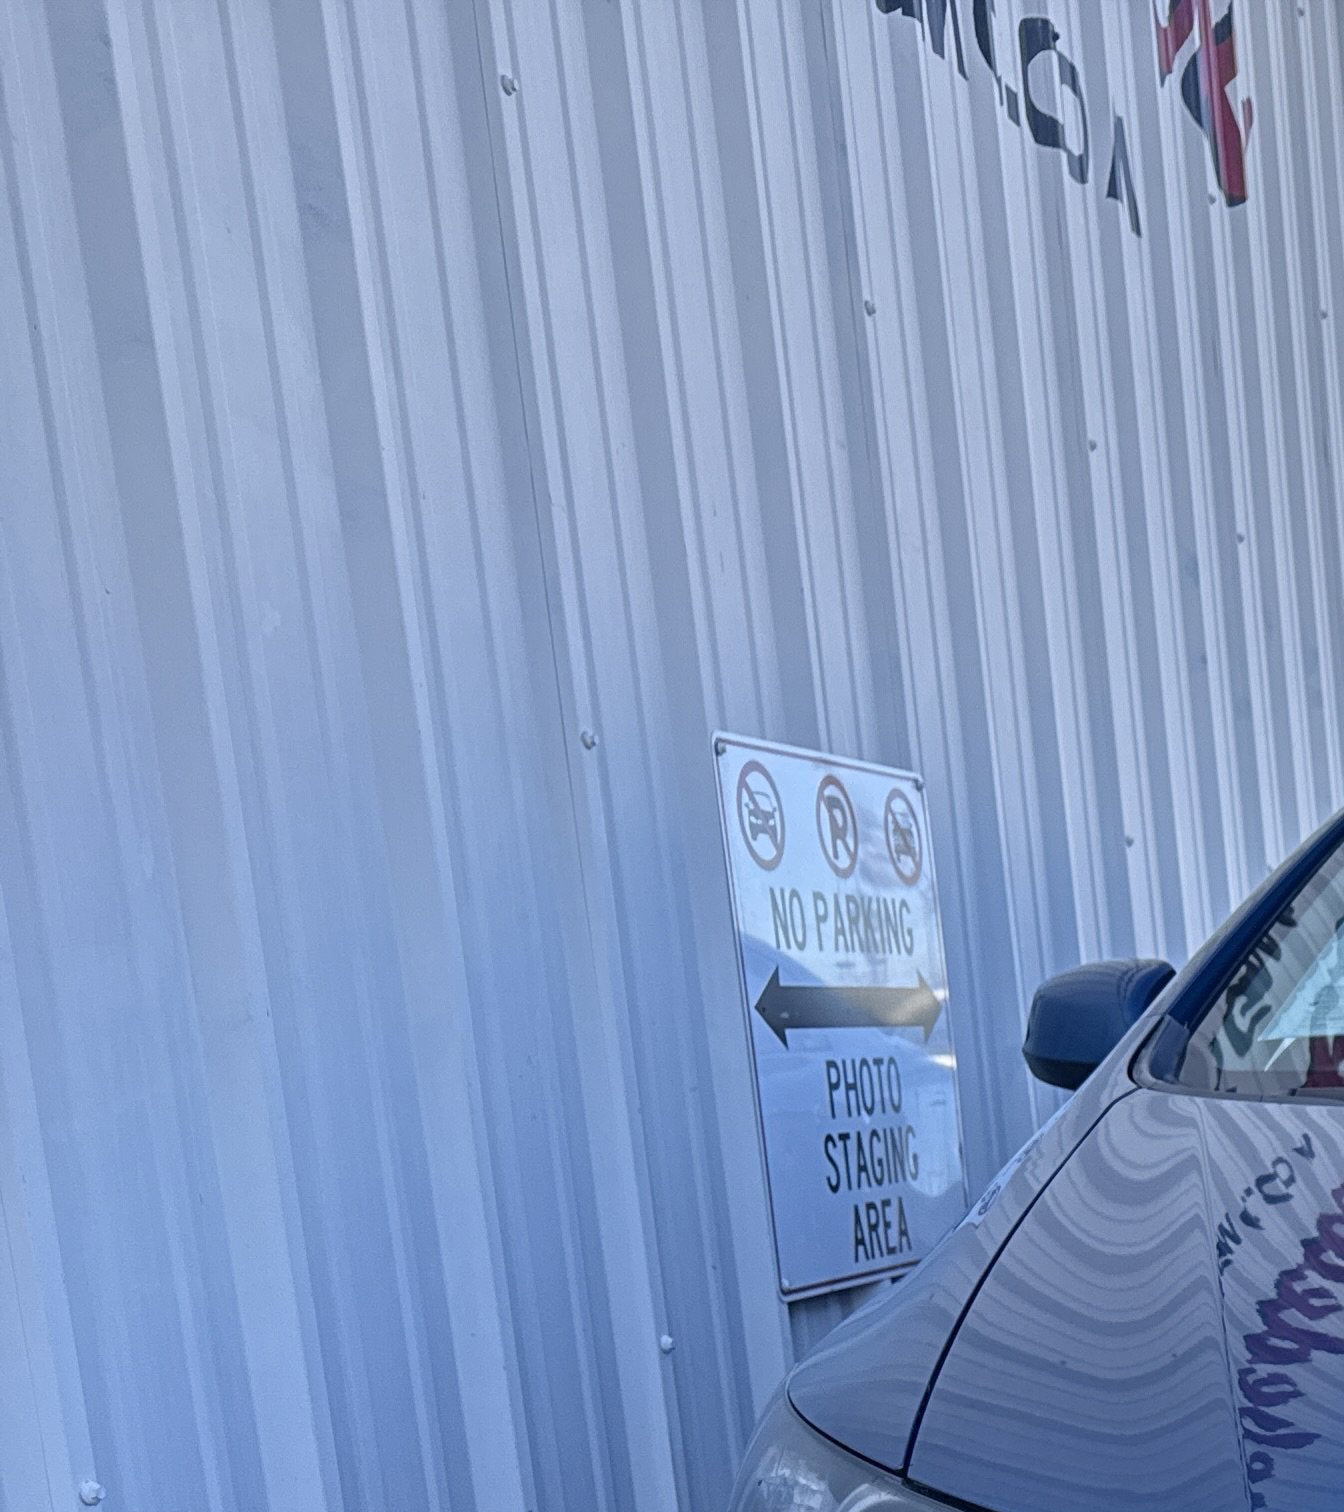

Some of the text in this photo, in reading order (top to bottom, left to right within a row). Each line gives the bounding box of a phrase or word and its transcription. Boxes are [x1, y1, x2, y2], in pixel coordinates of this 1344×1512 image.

[769, 887, 914, 956] NO PARKING
[825, 1056, 902, 1120] PHOTO
[823, 1124, 920, 1194] STAGING
[853, 1197, 913, 1263] AREA
